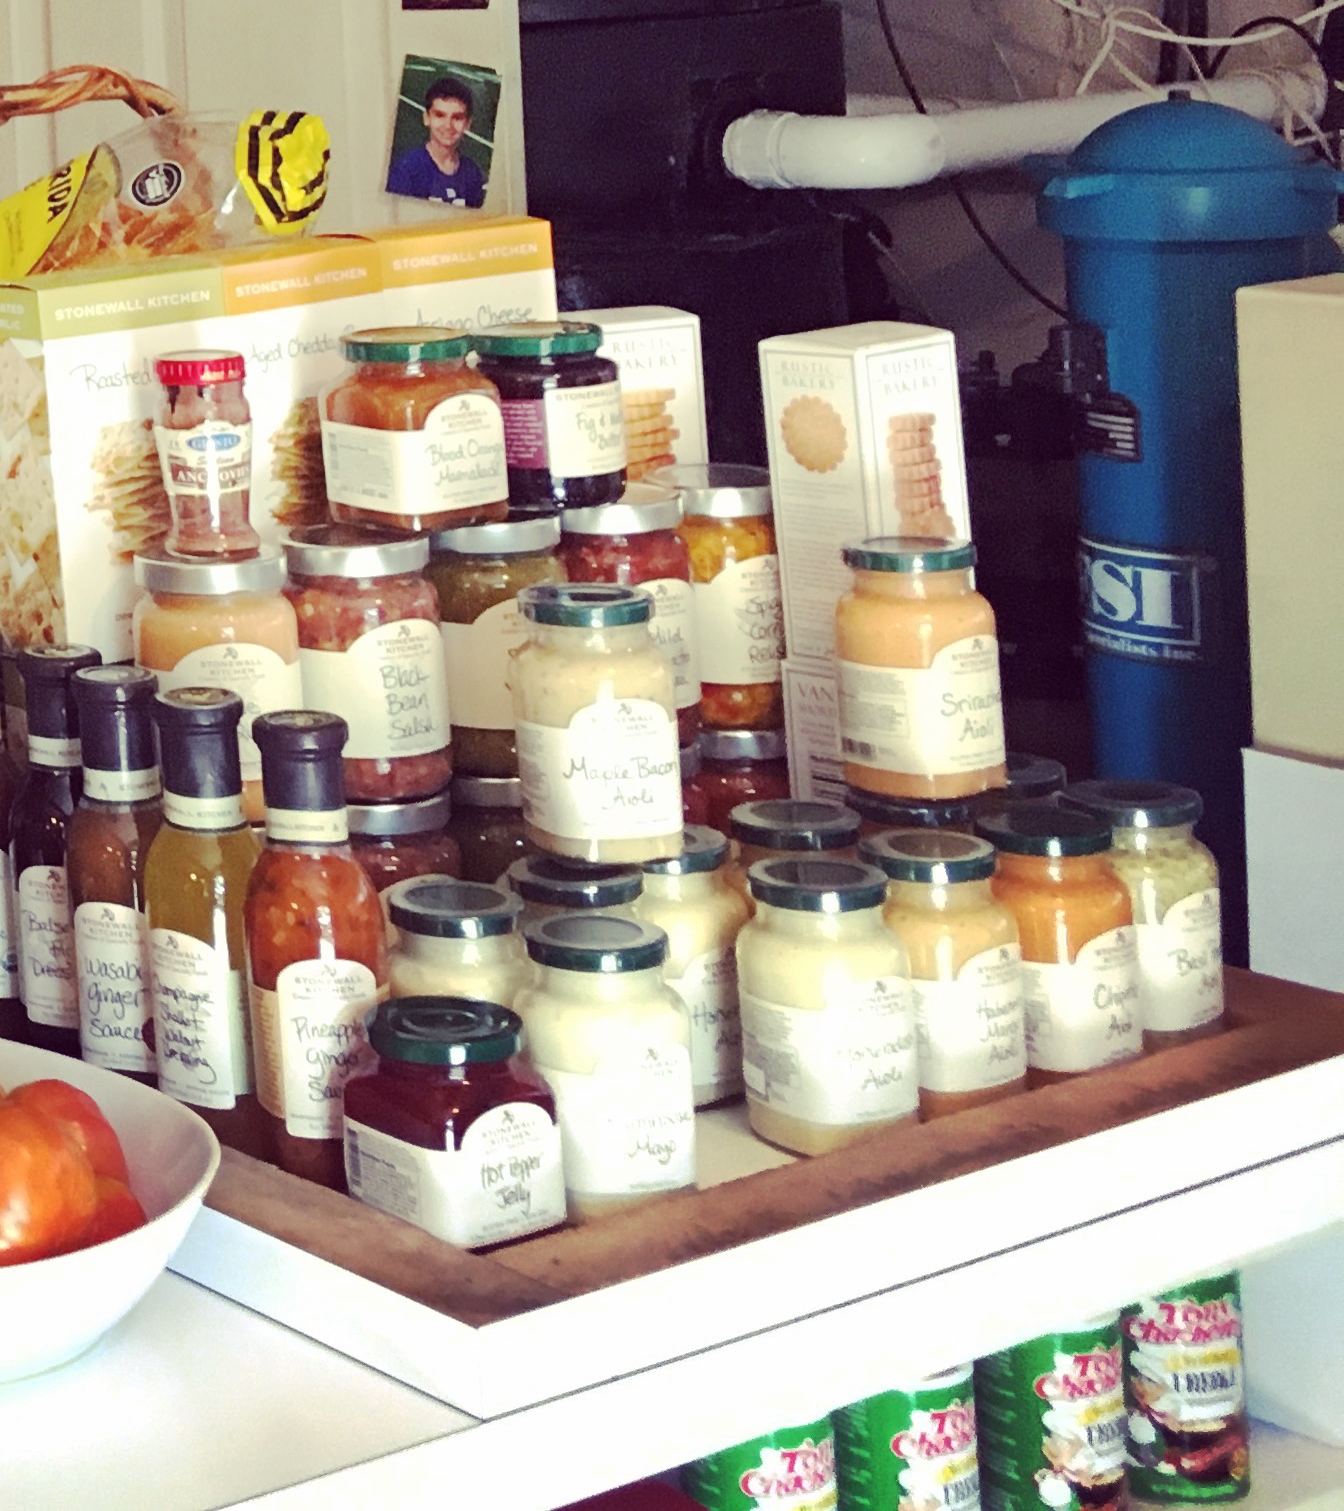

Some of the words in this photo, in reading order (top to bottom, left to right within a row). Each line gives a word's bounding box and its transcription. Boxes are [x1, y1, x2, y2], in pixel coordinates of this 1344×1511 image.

[393, 251, 473, 272] STONEWALL
[476, 242, 538, 262] KITCHEN
[235, 278, 310, 298] STONEWALL
[313, 267, 368, 287] KITCHEN
[54, 300, 144, 322] STONEWALL
[147, 289, 211, 309] KITCHEN
